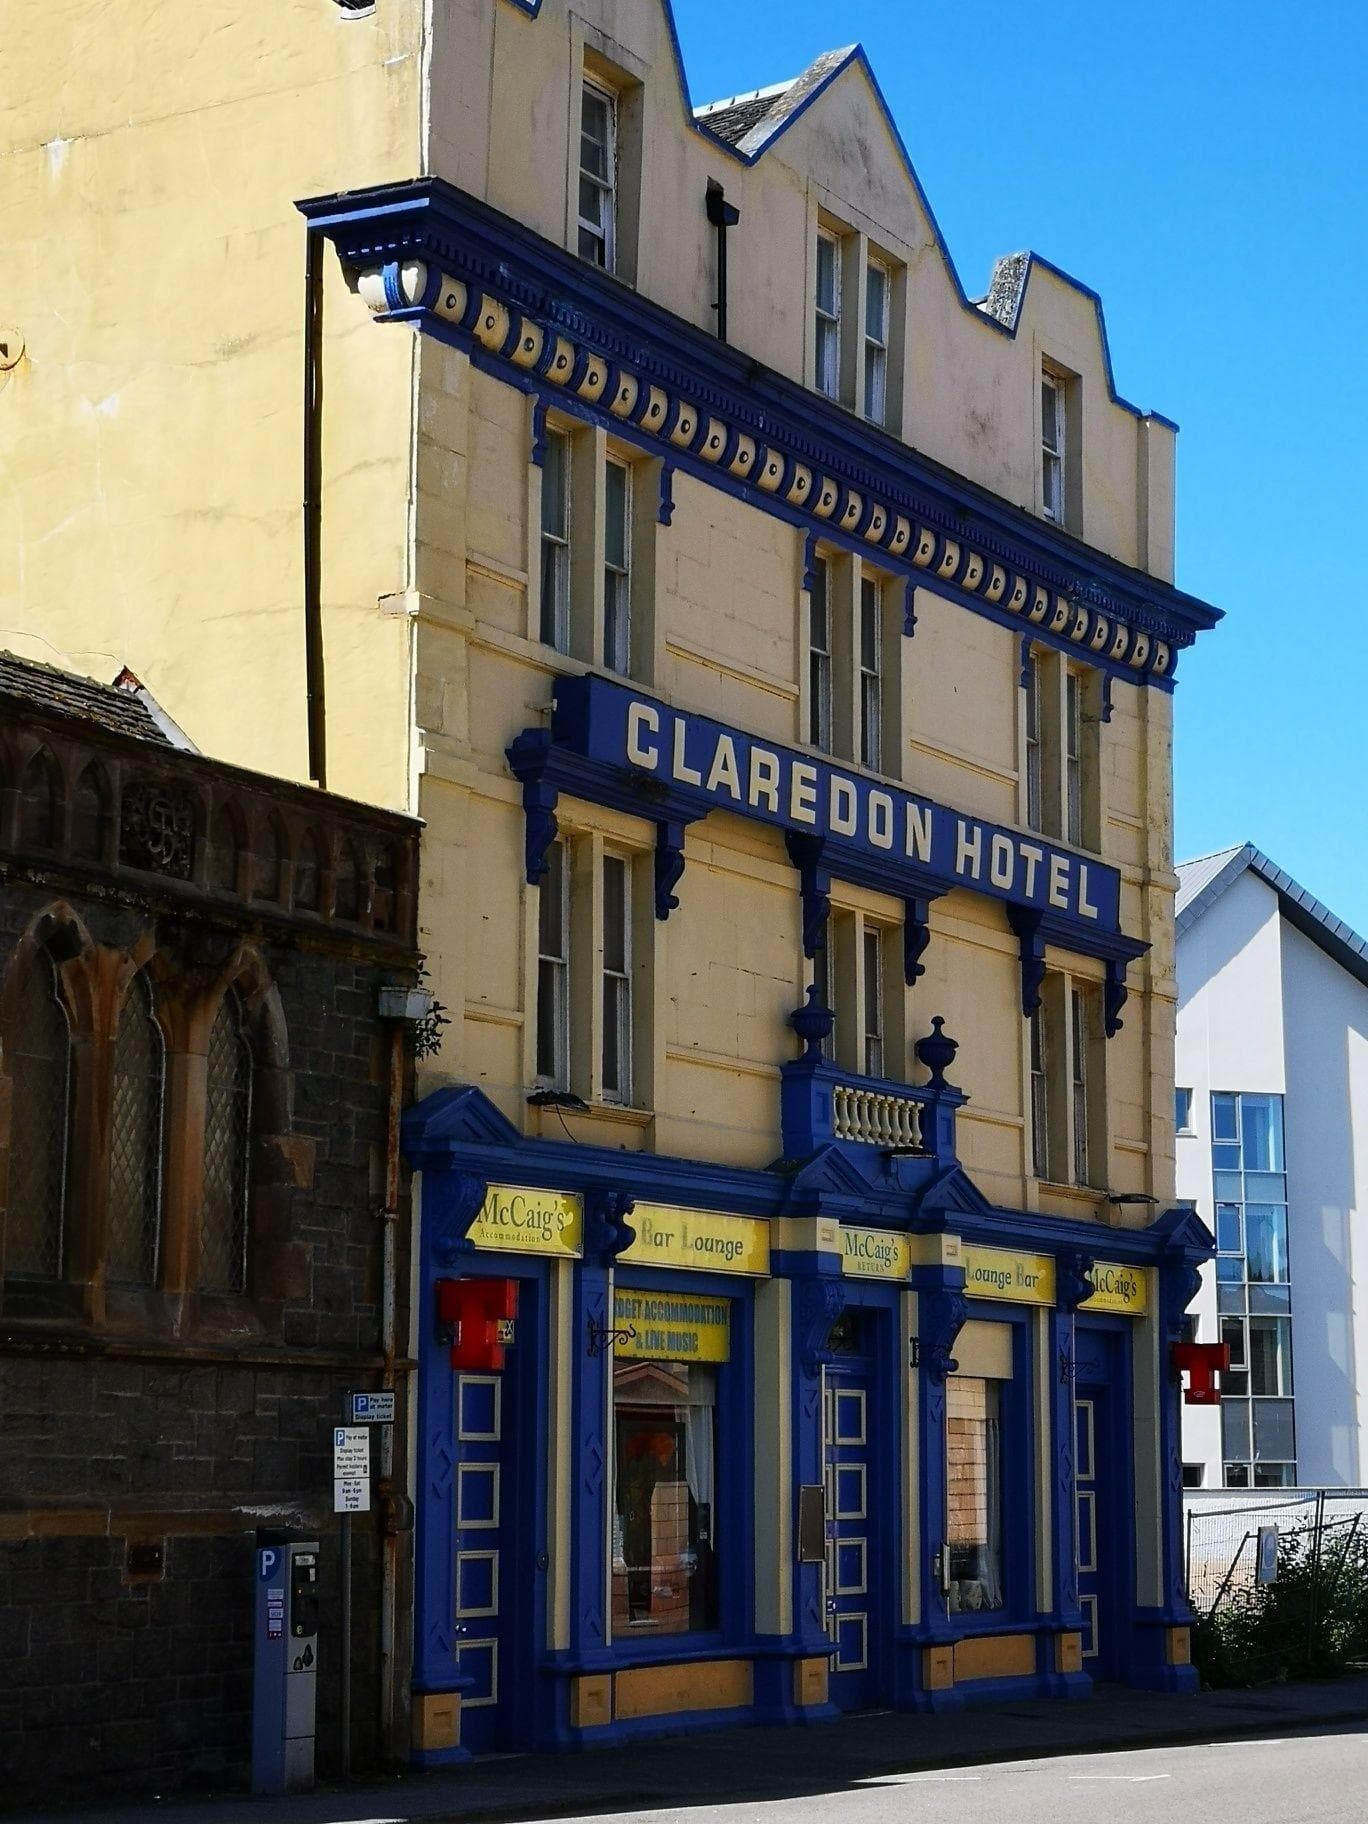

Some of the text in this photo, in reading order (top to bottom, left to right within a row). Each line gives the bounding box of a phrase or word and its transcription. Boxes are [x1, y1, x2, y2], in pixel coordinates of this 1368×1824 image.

[627, 701, 1098, 919] CLAREDON HOTEL
[477, 1193, 564, 1241] McCaig's
[480, 1228, 541, 1243] Accommodation
[641, 1217, 744, 1261] Bar Lounge
[845, 1232, 899, 1267] McCaig's
[965, 1257, 1040, 1289] Lounge Bar
[358, 1397, 367, 1410] P
[337, 1431, 344, 1445] P
[262, 1550, 275, 1576] P
